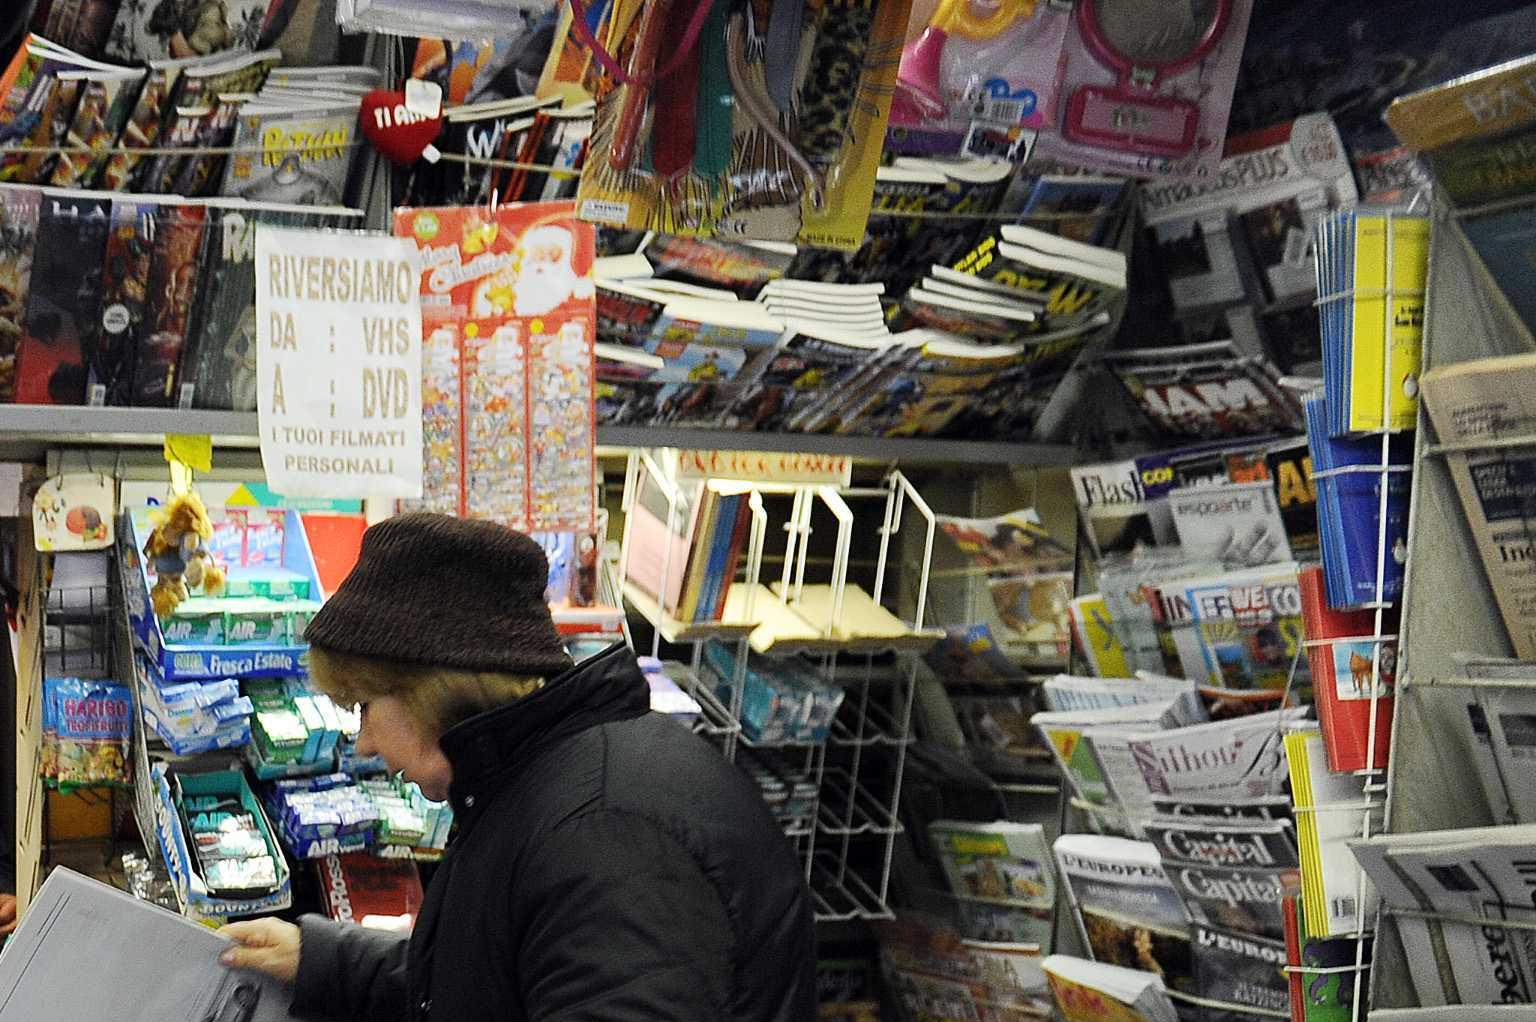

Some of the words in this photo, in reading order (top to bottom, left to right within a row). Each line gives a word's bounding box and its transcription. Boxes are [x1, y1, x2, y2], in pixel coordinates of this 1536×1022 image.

[268, 254, 413, 304] RIVERSIAMO
[269, 311, 297, 351] DA
[362, 316, 410, 355] VHS
[271, 364, 287, 416] A
[362, 367, 409, 419] DVD
[271, 427, 277, 443] I
[282, 427, 325, 445] TUOI
[330, 429, 406, 447] FILMATI
[284, 455, 395, 475] PERSONALI
[166, 621, 192, 640] AIR
[231, 620, 257, 640] AIR
[64, 699, 128, 717] HARIBO
[307, 839, 339, 857] AIR
[1180, 868, 1281, 908] Capital
